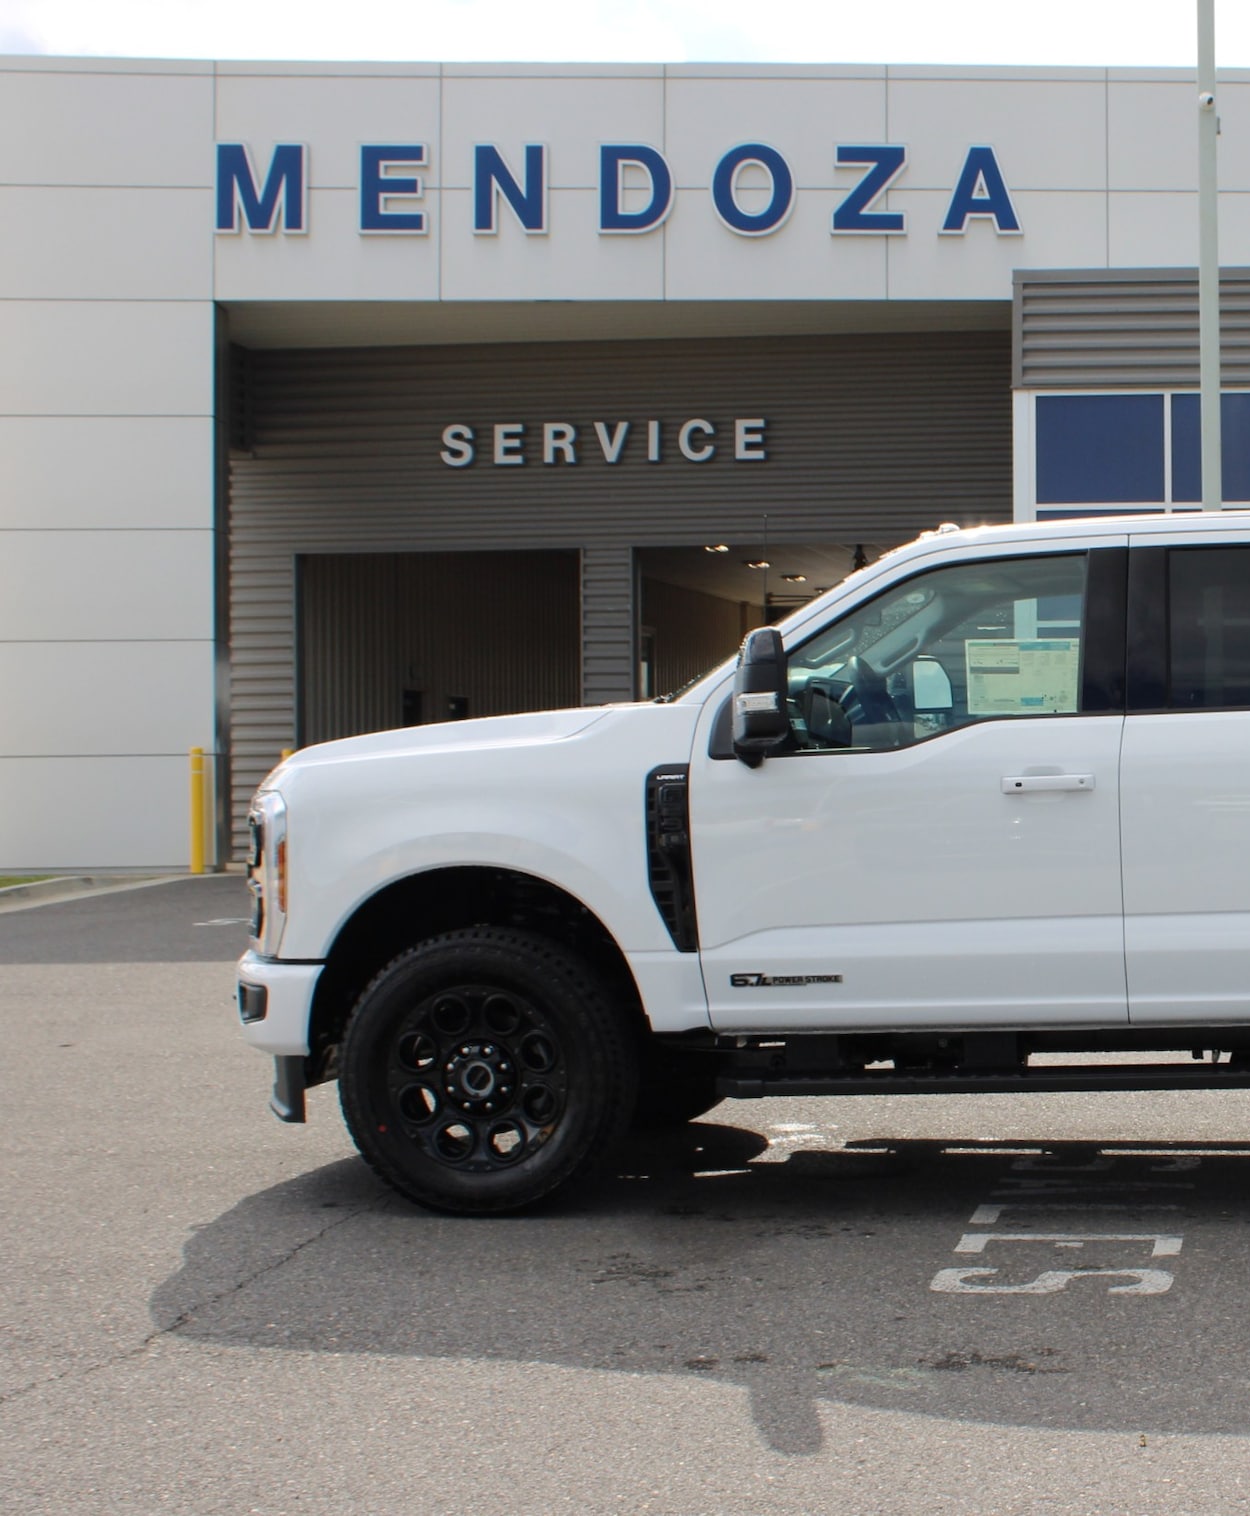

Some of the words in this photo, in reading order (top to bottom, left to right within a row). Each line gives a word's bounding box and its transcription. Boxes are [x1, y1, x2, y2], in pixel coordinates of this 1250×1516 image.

[214, 143, 1022, 238] MENDOZA
[439, 417, 769, 467] SERVICE
[772, 976, 803, 985] POWER
[805, 975, 842, 984] STROKE
